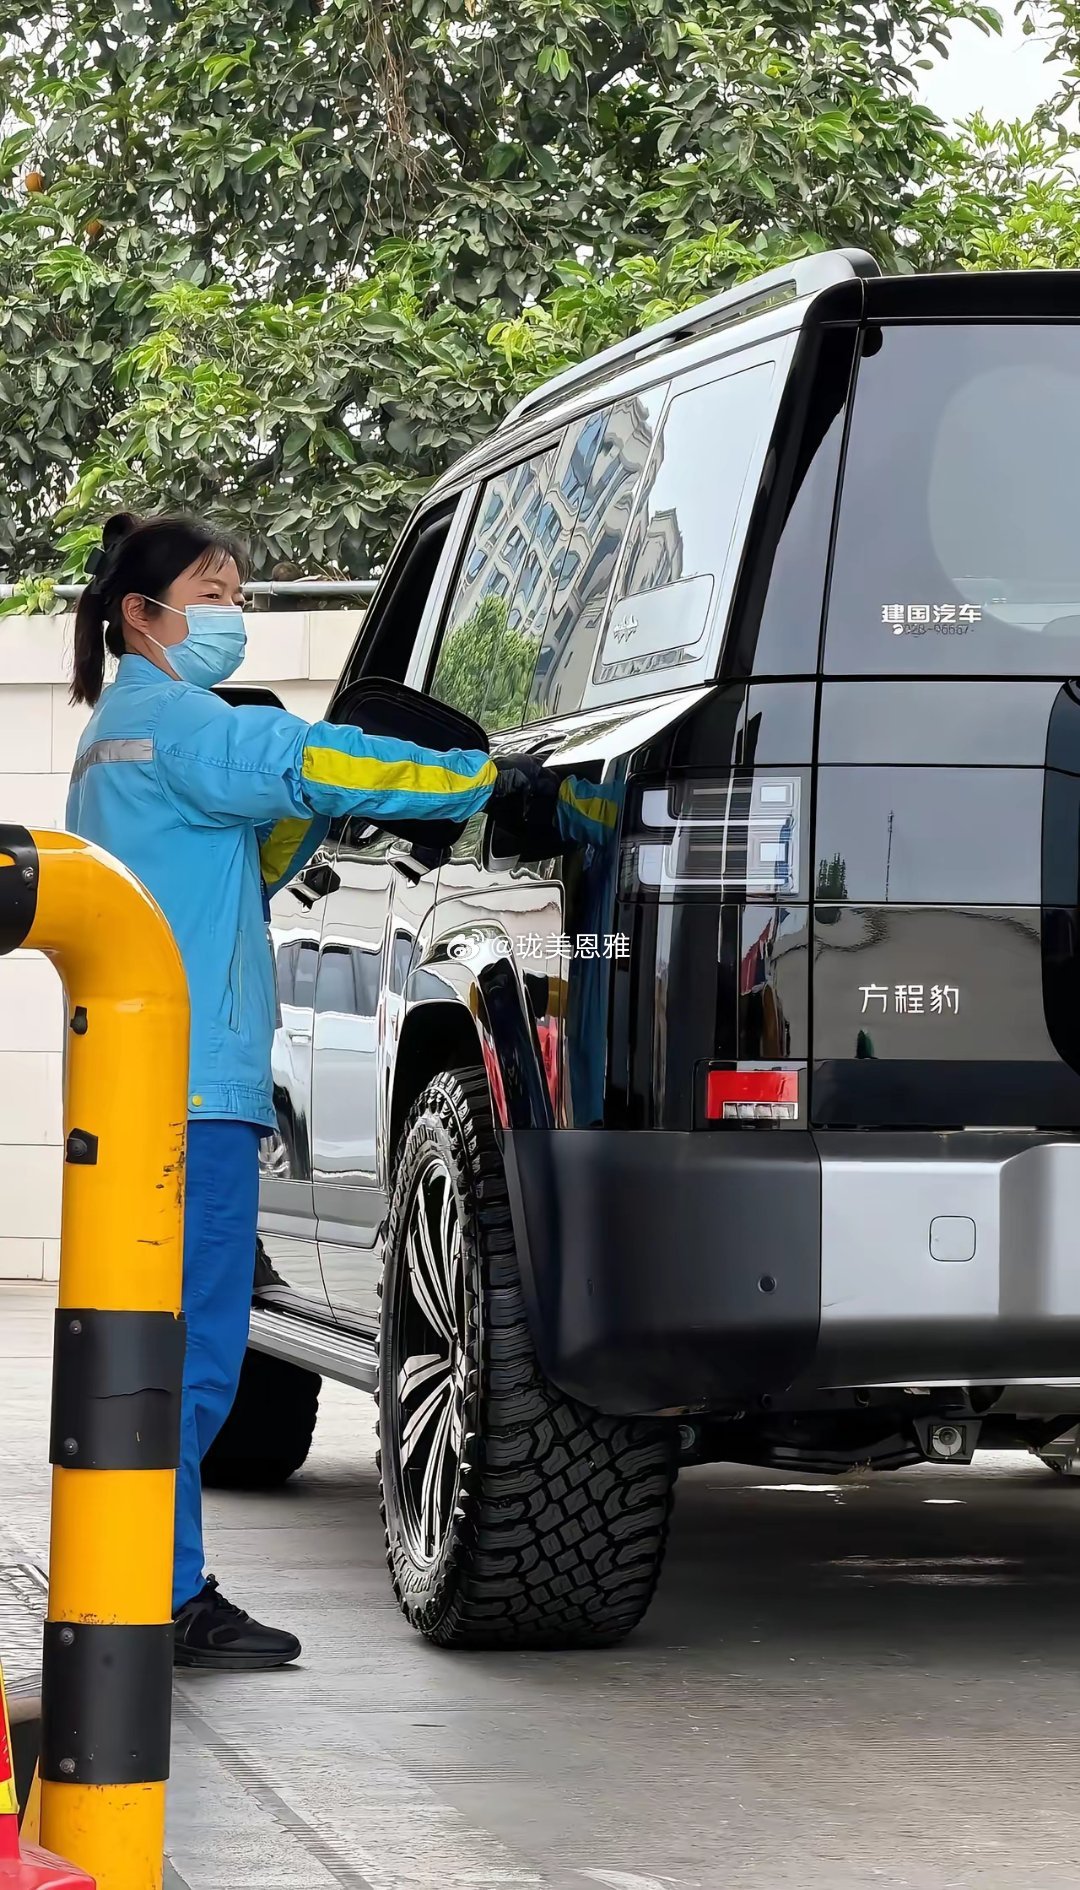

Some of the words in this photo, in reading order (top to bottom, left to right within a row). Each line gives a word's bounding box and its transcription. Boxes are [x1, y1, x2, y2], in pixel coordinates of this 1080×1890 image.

[881, 603, 982, 623] 建国汽车
[858, 983, 960, 1014] 方程豹
